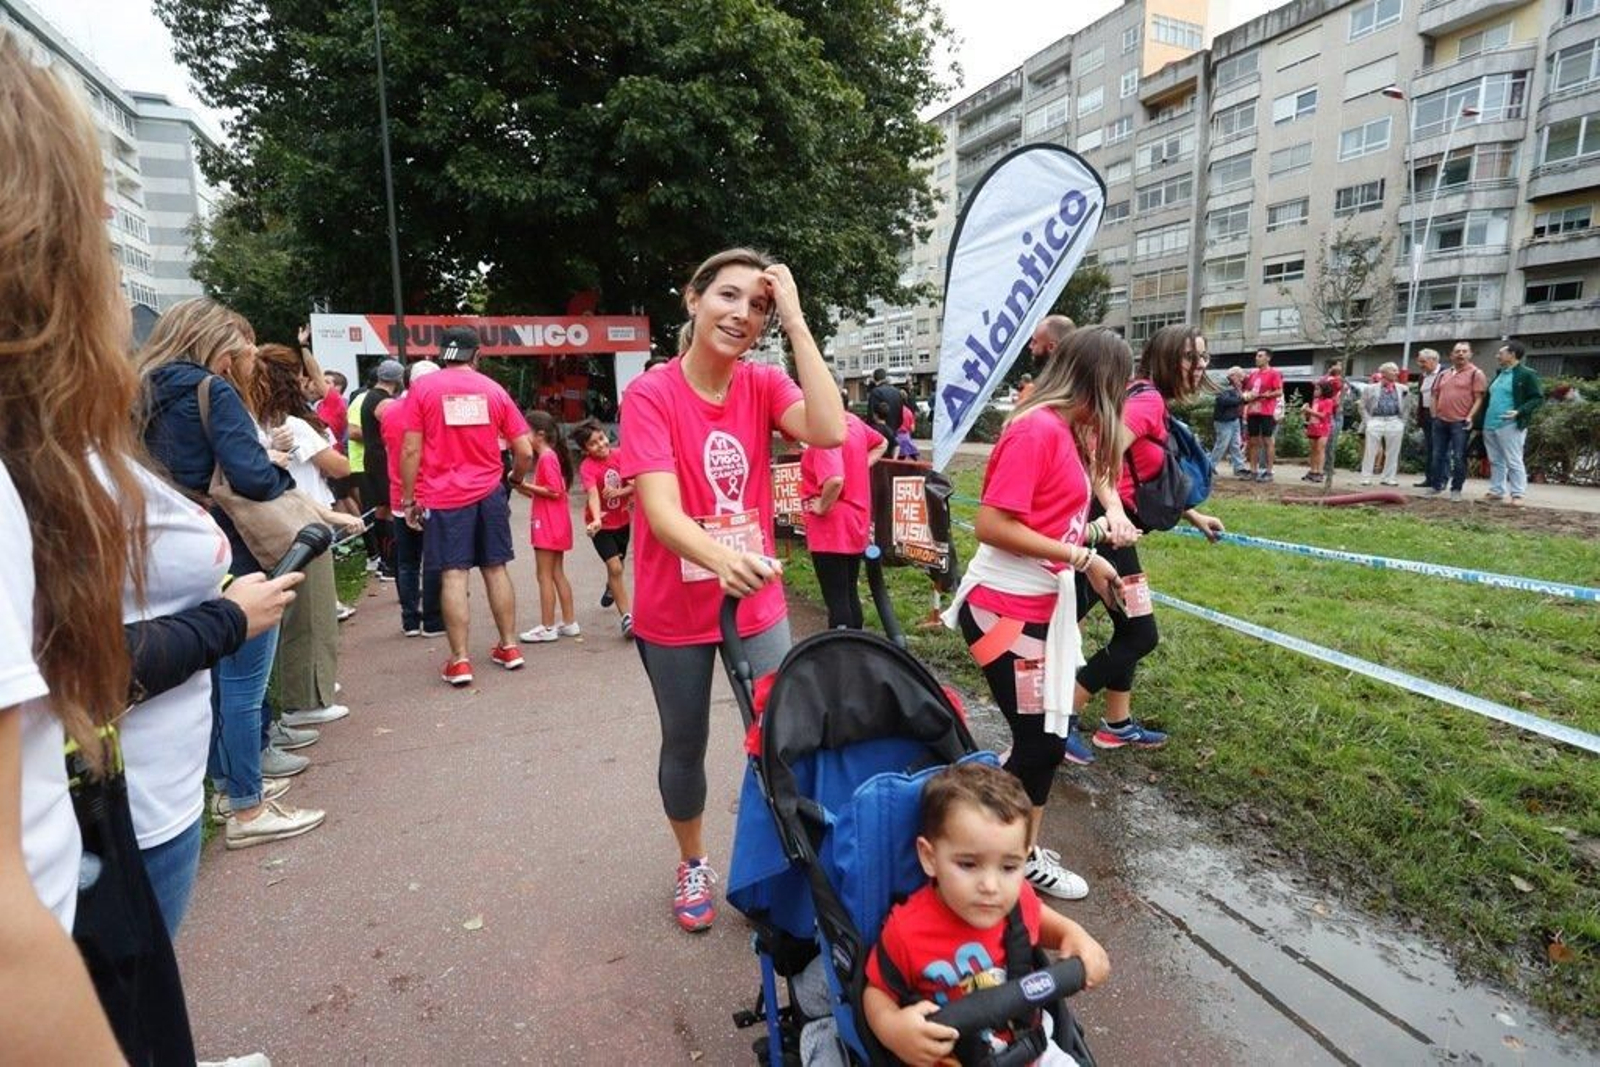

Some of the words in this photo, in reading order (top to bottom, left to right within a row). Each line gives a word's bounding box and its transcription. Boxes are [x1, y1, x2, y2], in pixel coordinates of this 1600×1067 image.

[941, 189, 1087, 433] Atlántico
[710, 453, 741, 467] VIGO
[775, 466, 804, 483] SAVE
[775, 483, 799, 499] THE
[896, 481, 925, 501] SAV
[774, 497, 803, 513] MUS
[896, 502, 919, 522] THE
